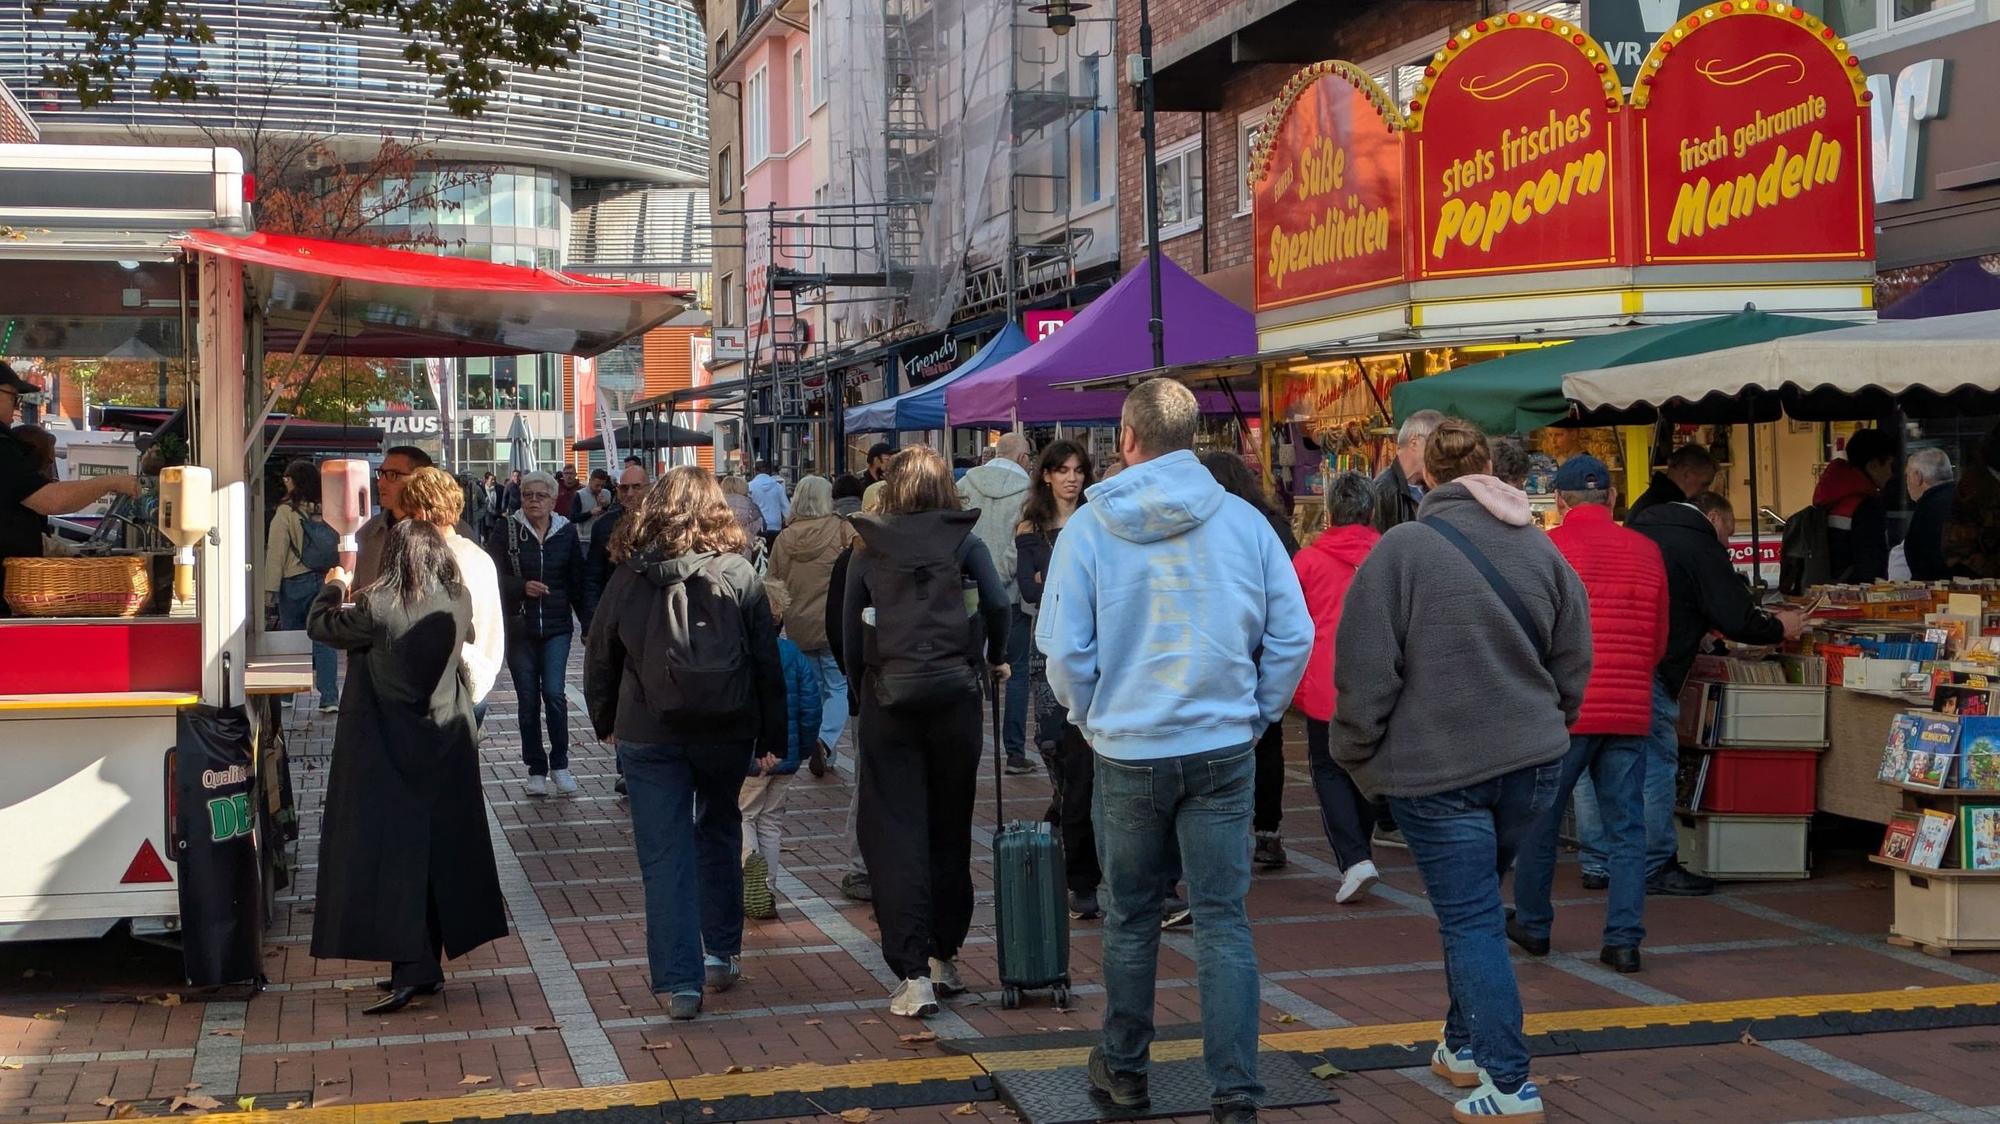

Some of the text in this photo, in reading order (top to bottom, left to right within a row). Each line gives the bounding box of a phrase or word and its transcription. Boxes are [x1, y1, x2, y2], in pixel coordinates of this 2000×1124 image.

[1603, 41, 1642, 66] VR
[1299, 135, 1346, 202] Süße
[1442, 107, 1592, 198] stets frisches
[1679, 94, 1827, 174] frisch gebrannte
[1667, 130, 1842, 246] Mandeln
[1268, 193, 1389, 290] Spezialitäten
[904, 333, 958, 377] Trendy
